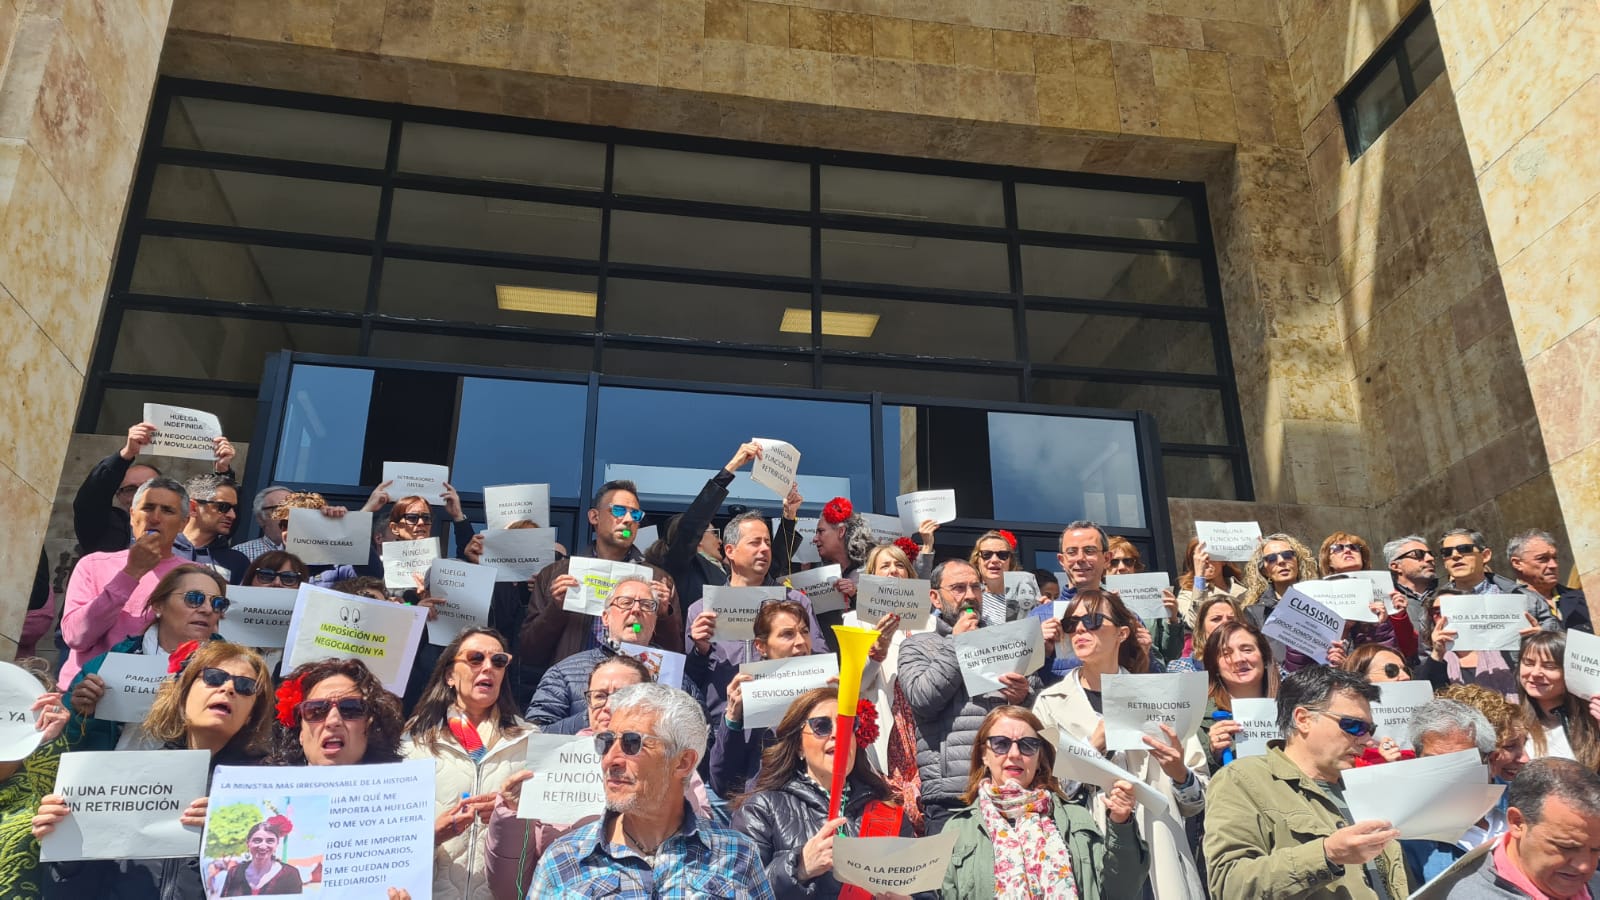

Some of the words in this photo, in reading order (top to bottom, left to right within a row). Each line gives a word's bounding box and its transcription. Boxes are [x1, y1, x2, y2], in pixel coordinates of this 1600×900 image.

[879, 587, 914, 596] NINGUNA
[870, 597, 905, 608] FUNCIÓN
[1290, 597, 1339, 630] CLASISMO
[320, 623, 370, 640] IMPOSICIÓN
[372, 634, 386, 642] NO
[314, 636, 372, 655] NEGOCIACIÓN
[372, 648, 384, 656] YA
[964, 652, 973, 660] NI
[974, 648, 992, 656] UNA
[992, 640, 1027, 653] FUNCIÓN
[982, 648, 1034, 664] RETRIBUCIÓN
[1571, 652, 1580, 660] NI
[1581, 654, 1599, 666] UNA
[754, 667, 825, 680] #HuelgaEnJusticia
[1570, 662, 1582, 672] SIN
[124, 685, 136, 693] DE
[138, 686, 150, 694] LA
[752, 688, 794, 698] SERVICIOS
[1128, 702, 1190, 710] RETRIBUCIONES
[8, 712, 26, 722] YA
[1146, 714, 1176, 722] JUSTAS
[1254, 720, 1272, 728] UNA
[296, 780, 357, 790] IRRESPONSABLE
[372, 778, 382, 786] LA
[384, 776, 418, 784] HISTORIA
[546, 770, 604, 784] FUNCIÓN
[62, 786, 74, 797] NI
[78, 786, 106, 796] UNA
[110, 782, 174, 796] FUNCIÓN
[362, 792, 381, 802] QUÉ
[384, 792, 397, 800] ME
[85, 798, 180, 812] RETRIBUCIÓN
[330, 806, 370, 814] IMPORTA
[384, 800, 428, 812] HUELGA!!!
[342, 820, 356, 828] ME
[360, 818, 376, 826] VOY
[400, 814, 426, 822] FERIA.
[354, 838, 368, 846] ME
[371, 834, 418, 846] IMPORTAN
[326, 852, 342, 860] LOS
[344, 846, 414, 860] FUNCIONARIOS,
[334, 866, 348, 874] ME
[351, 862, 390, 874] QUEDAN
[392, 860, 410, 868] DOS
[847, 860, 862, 870] NO
[874, 866, 886, 874] LA
[324, 875, 386, 888] TELEDIARIOS!!
